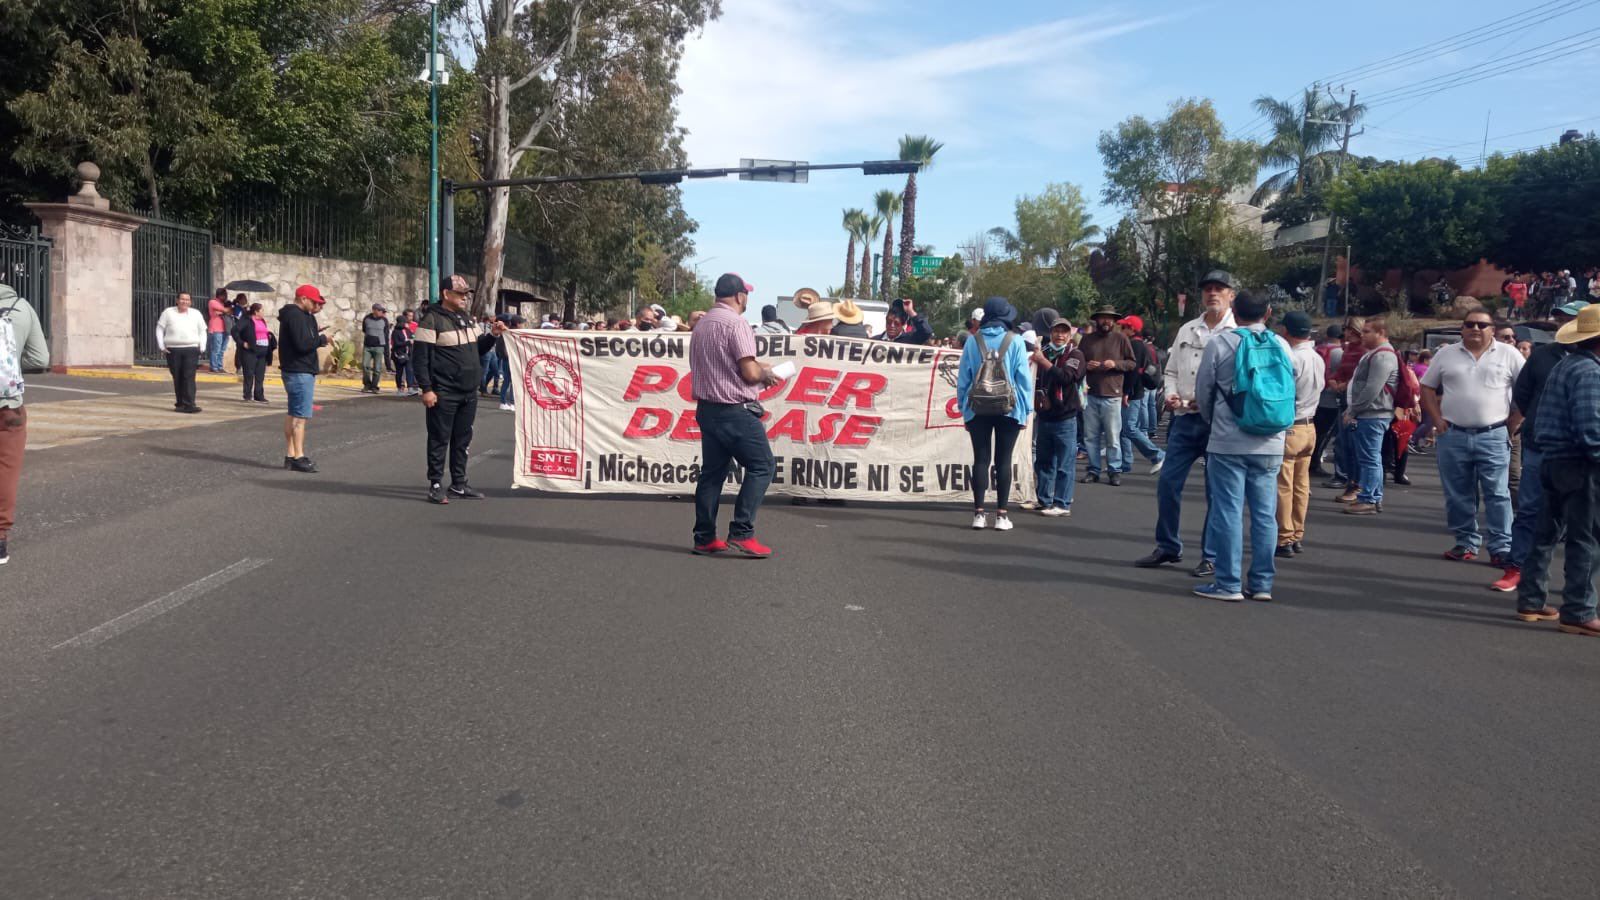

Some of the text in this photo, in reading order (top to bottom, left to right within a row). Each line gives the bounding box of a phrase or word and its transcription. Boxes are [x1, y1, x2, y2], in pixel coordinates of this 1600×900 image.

[580, 334, 935, 365] SECCIÓN DEL SNTE/CNTE
[623, 364, 889, 411] PER
[760, 408, 883, 448] ASE
[537, 453, 572, 464] SNTE
[791, 457, 858, 489] RINDE
[867, 464, 889, 491] NI
[900, 465, 925, 492] SE
